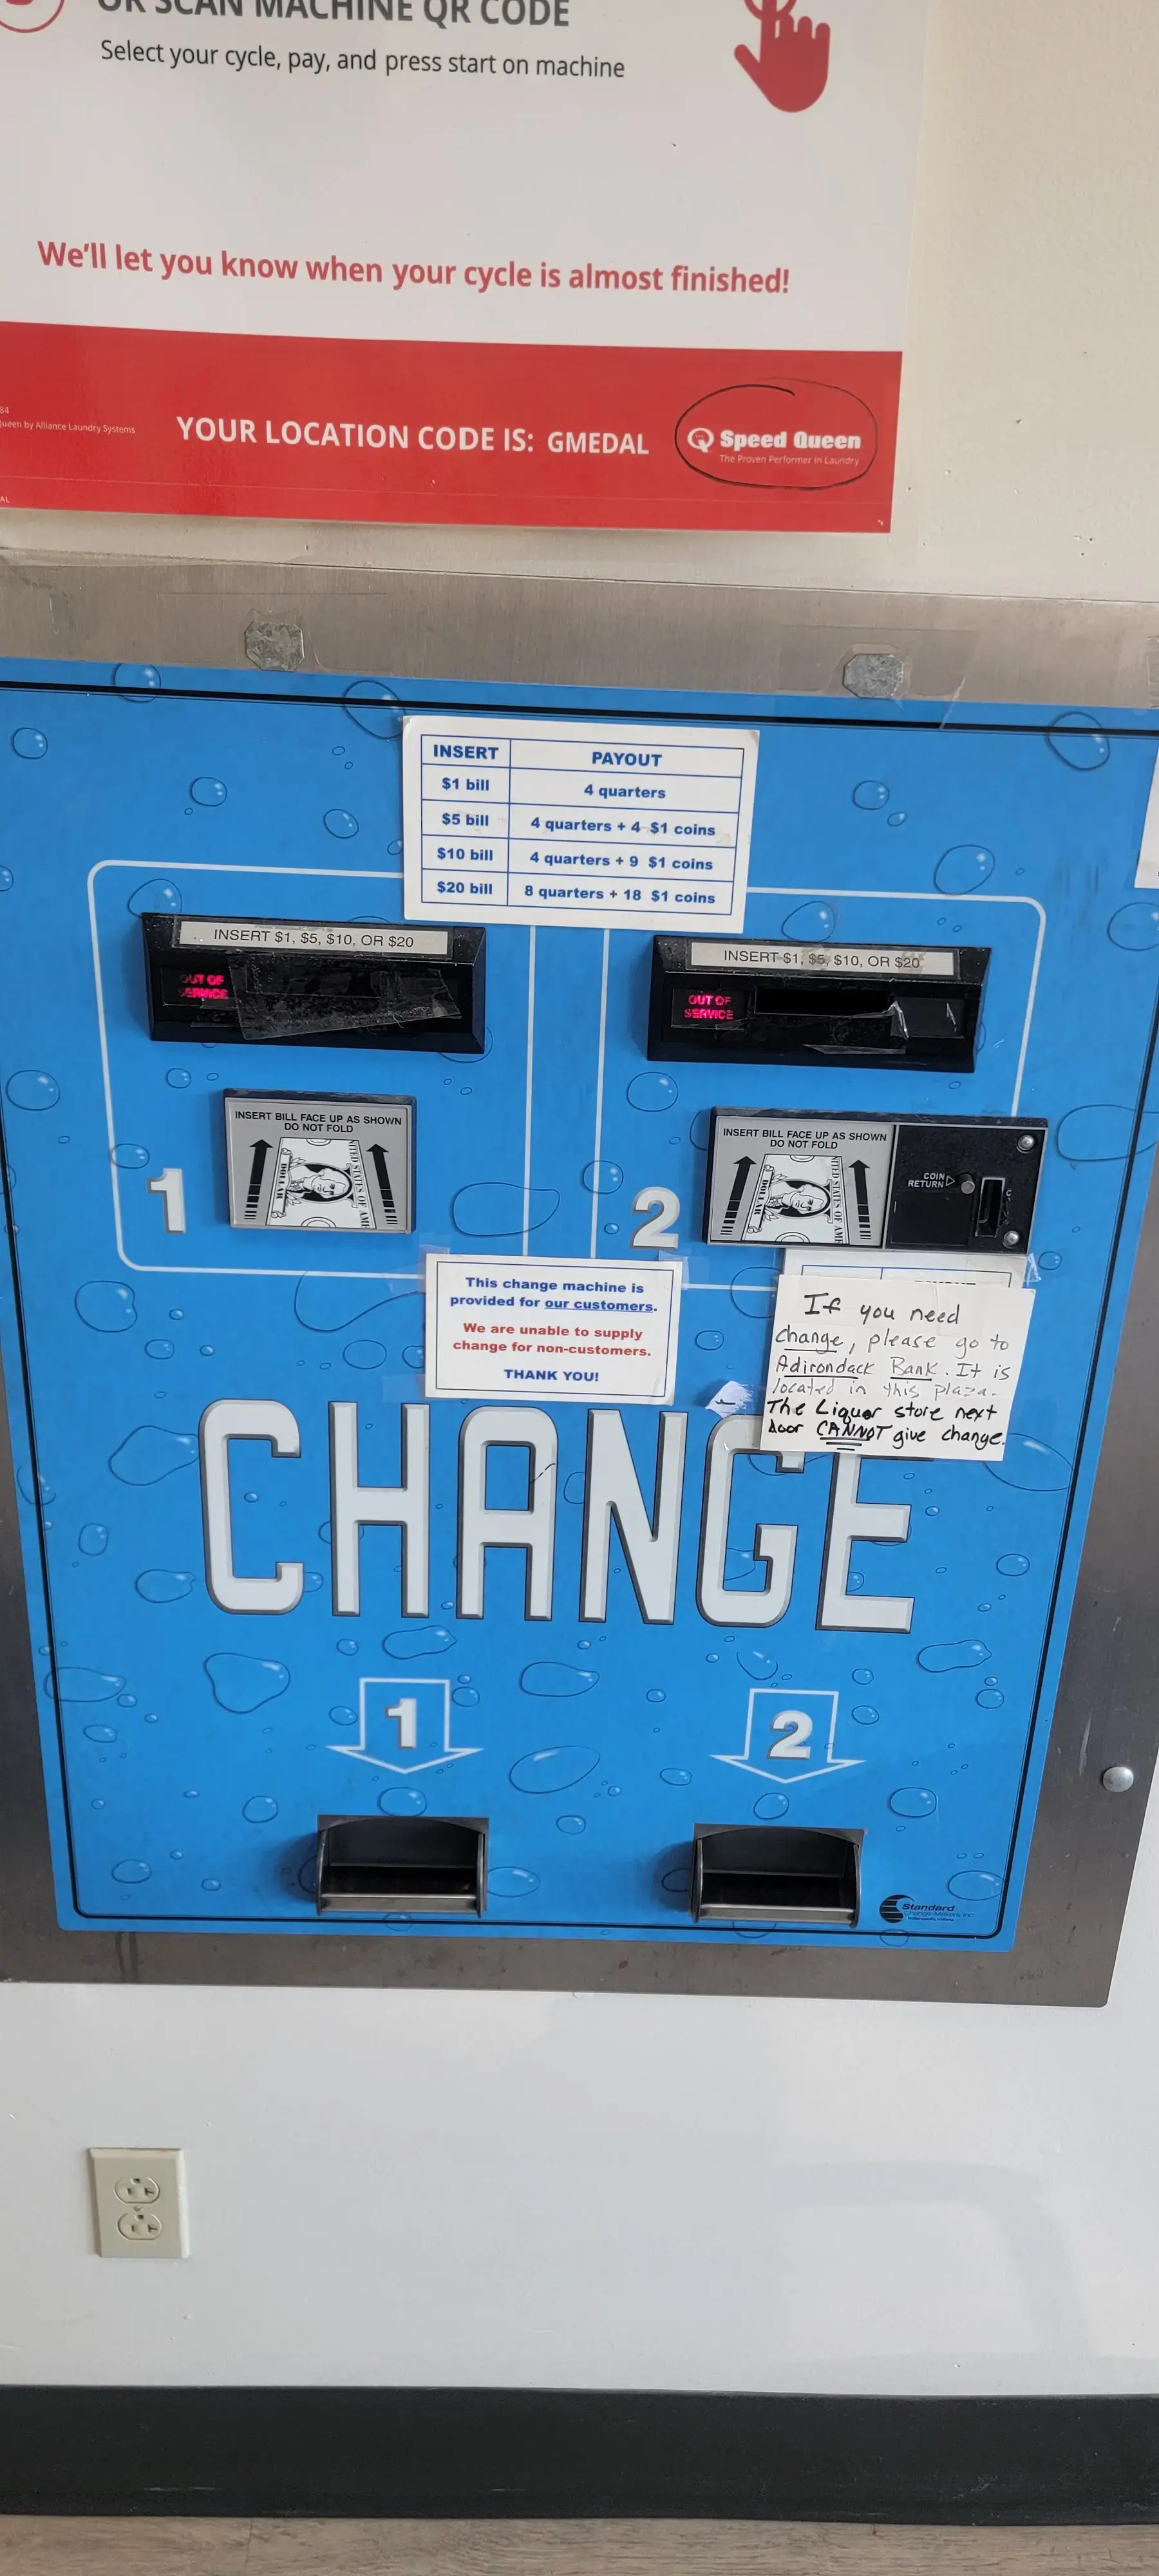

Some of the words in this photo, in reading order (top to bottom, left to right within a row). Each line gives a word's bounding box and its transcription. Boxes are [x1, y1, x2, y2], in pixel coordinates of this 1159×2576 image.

[256, 0, 413, 21] MACHINE
[424, 0, 471, 29] QR
[481, 0, 569, 26] CODE
[101, 40, 164, 63] Select
[170, 46, 219, 68] your
[225, 46, 281, 72] cycle,
[288, 53, 330, 73] pay,
[337, 50, 376, 70] and
[386, 54, 442, 76] press
[449, 53, 496, 74] start
[502, 58, 529, 75] on
[536, 55, 625, 78] machine
[116, 245, 153, 272] let
[159, 253, 212, 280] you
[221, 251, 297, 279] know
[306, 256, 382, 282] when
[393, 263, 456, 290] your
[464, 260, 532, 292] cycle
[540, 262, 561, 288] is
[569, 264, 663, 291] almost
[670, 265, 789, 293] finished!
[24, 420, 33, 431] by
[35, 422, 66, 431] Alliance
[69, 423, 101, 434] Laundry
[103, 424, 136, 435] Systems
[176, 417, 256, 443] YOUR
[266, 421, 409, 449] LOCATION
[418, 426, 495, 451] CODE
[504, 428, 534, 451] IS:
[547, 431, 649, 455] GMEDAL
[720, 430, 787, 451] Speed
[793, 431, 861, 449] Queen
[720, 455, 735, 463] The
[738, 455, 766, 464] Proven
[769, 455, 811, 465] Performer
[814, 456, 822, 465] in
[825, 457, 860, 467] Laundry
[433, 744, 498, 760] INSERT
[592, 752, 662, 767] PAYOUT
[442, 777, 460, 791] $1
[466, 778, 489, 791] bill
[584, 784, 594, 796] 4
[598, 786, 666, 800] quarters
[442, 813, 460, 826] $5
[466, 814, 489, 826] bill
[531, 817, 540, 829] 4
[545, 819, 611, 833] quarters
[630, 822, 640, 833] 4
[650, 822, 667, 835] $1
[674, 824, 715, 836] coins
[437, 847, 464, 861] $10
[470, 848, 493, 861] bill
[530, 852, 539, 863] 4
[544, 853, 610, 867] quarters
[629, 857, 638, 867] 9
[648, 856, 666, 869] $1
[672, 858, 713, 870] coins
[437, 881, 464, 895] $20
[470, 882, 493, 895] bill
[525, 886, 533, 896] 8
[538, 887, 603, 901] quarters
[624, 890, 641, 900] 18
[651, 890, 668, 903] $1
[675, 892, 715, 904] coins
[214, 929, 270, 942] INSERT
[274, 931, 296, 944] $1,
[300, 933, 322, 945] $5,
[326, 934, 355, 947] $10,
[361, 935, 384, 947] OR
[388, 936, 413, 948] $20
[724, 950, 777, 963] INSERT
[783, 952, 804, 965] $1,
[808, 953, 829, 967] $5,
[833, 955, 863, 968] $10,
[867, 956, 890, 968] OR
[894, 956, 919, 969] $20
[689, 994, 713, 1006] OUT
[715, 996, 731, 1005] OF
[684, 1009, 733, 1020] SERVICE
[235, 1112, 271, 1121] INSERT
[276, 1113, 297, 1121] BILL
[346, 1116, 361, 1124] AS
[364, 1117, 402, 1125] SHOWN
[284, 1122, 299, 1132] DO
[303, 1124, 323, 1132] NOT
[326, 1124, 353, 1133] FOLD
[723, 1129, 759, 1137] INSERT
[762, 1130, 783, 1139] BILL
[787, 1131, 812, 1139] FACE
[816, 1132, 829, 1140] UP
[849, 1133, 887, 1142] SHOWN
[769, 1140, 784, 1148] DO
[147, 1168, 185, 1234] 1
[630, 1187, 680, 1249] 2
[466, 1277, 498, 1288] This
[503, 1279, 558, 1292] change
[562, 1281, 627, 1293] machine
[632, 1283, 644, 1293] is
[450, 1295, 514, 1307] provided
[520, 1297, 540, 1307] for
[545, 1299, 569, 1309] our
[574, 1300, 657, 1312] customers.
[804, 1293, 840, 1315] If
[860, 1304, 895, 1325] you
[910, 1303, 959, 1324] need
[463, 1323, 485, 1333] We
[491, 1326, 514, 1334] are
[520, 1325, 569, 1336] unable
[575, 1327, 589, 1337] to
[594, 1329, 643, 1341] supply
[453, 1341, 507, 1352] change
[512, 1342, 532, 1352] for
[536, 1343, 652, 1356] non-customers.
[775, 1325, 855, 1354] change,
[868, 1328, 936, 1353] please
[953, 1337, 979, 1359] go
[990, 1334, 1009, 1350] to
[504, 1369, 558, 1381] THANK
[563, 1371, 599, 1382] YOU!
[775, 1354, 875, 1376] Adirondack
[956, 1363, 982, 1378] It
[994, 1365, 1011, 1380] is
[772, 1378, 834, 1396] located
[849, 1380, 866, 1395] in
[883, 1382, 919, 1399] this
[934, 1383, 997, 1401] plaza.
[767, 1397, 806, 1416] The
[815, 1398, 882, 1425] Liquor
[894, 1401, 944, 1421] store
[955, 1405, 998, 1422] next
[816, 1421, 894, 1440] CANNOT
[892, 1428, 926, 1449] give
[941, 1425, 1005, 1450] change.
[198, 1399, 934, 1633] CHANGE
[386, 1698, 417, 1749] 1
[767, 1710, 813, 1760] 2
